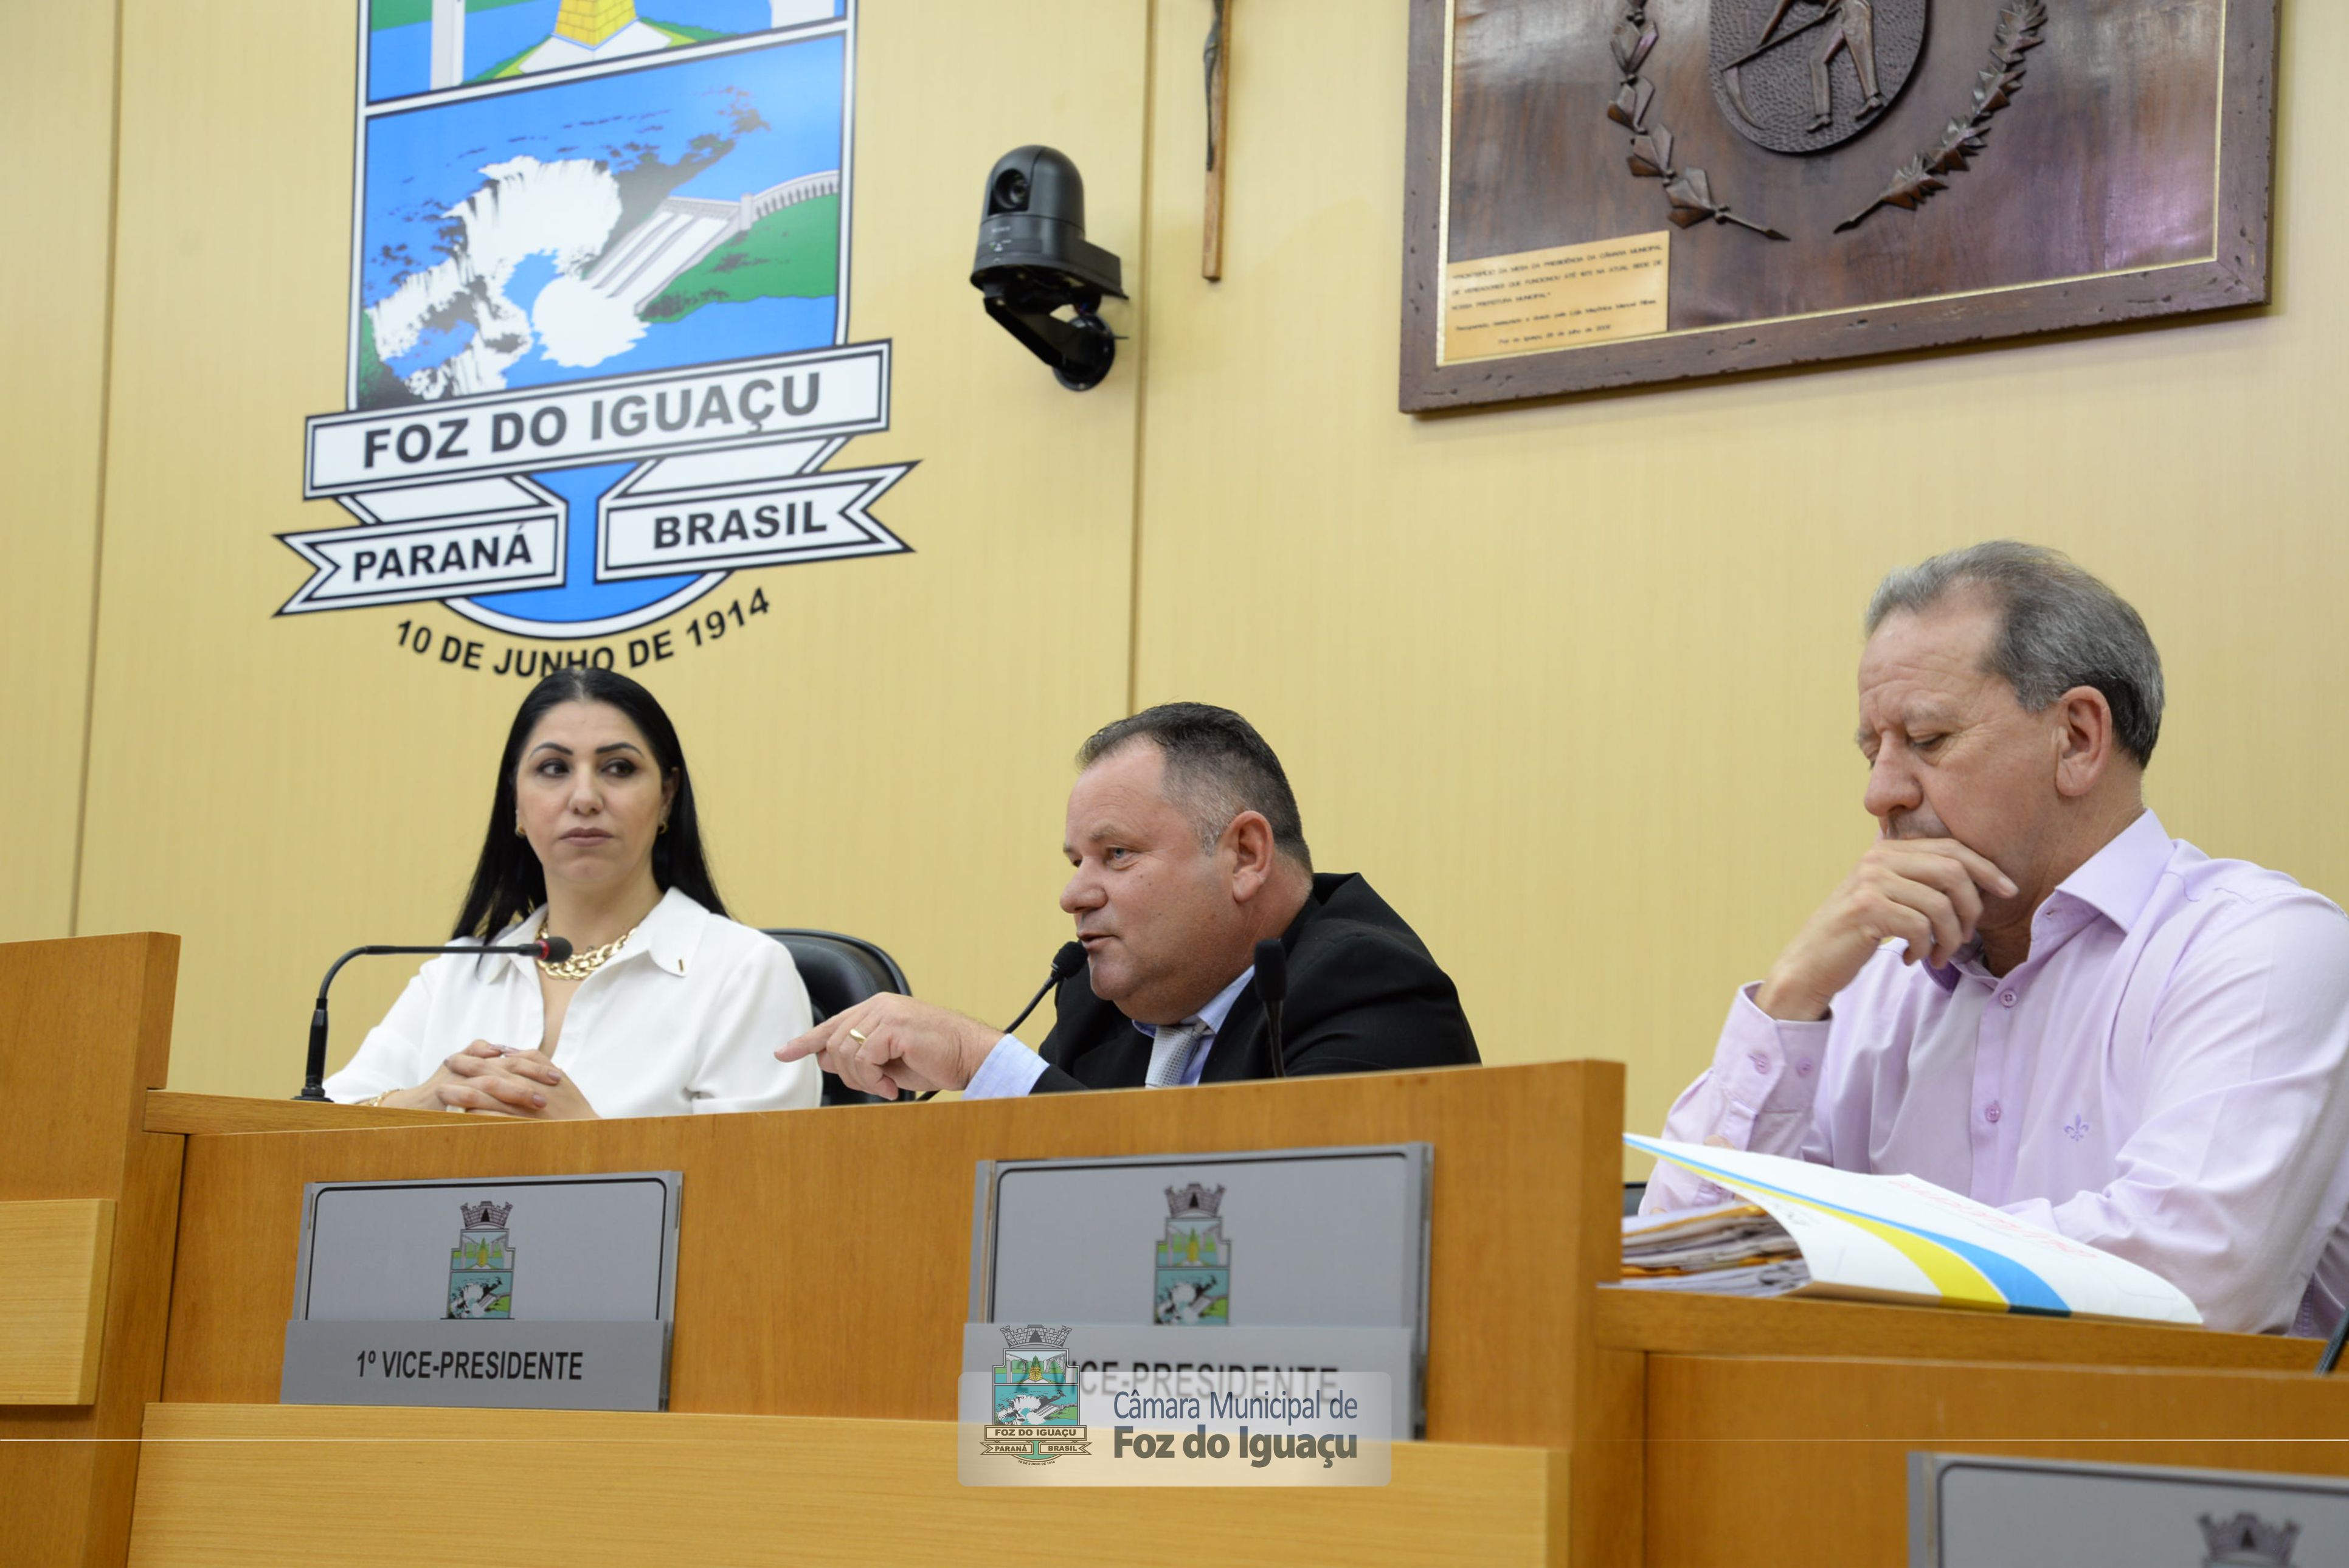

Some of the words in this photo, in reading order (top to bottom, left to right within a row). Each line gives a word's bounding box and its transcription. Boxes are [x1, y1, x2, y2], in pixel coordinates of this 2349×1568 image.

[364, 418, 469, 469] FOZ
[491, 406, 567, 453] DO
[591, 373, 819, 440] IGUAÇU
[353, 525, 532, 582] PARANÁ
[654, 501, 827, 549] BRASIL
[398, 620, 432, 654] 10
[440, 635, 484, 670] DE
[493, 646, 614, 678] JUNHO
[628, 630, 674, 668] DE
[687, 587, 769, 646] 1914
[357, 1350, 376, 1377] 1º
[382, 1350, 583, 1380] VICE-PRESIDENTE
